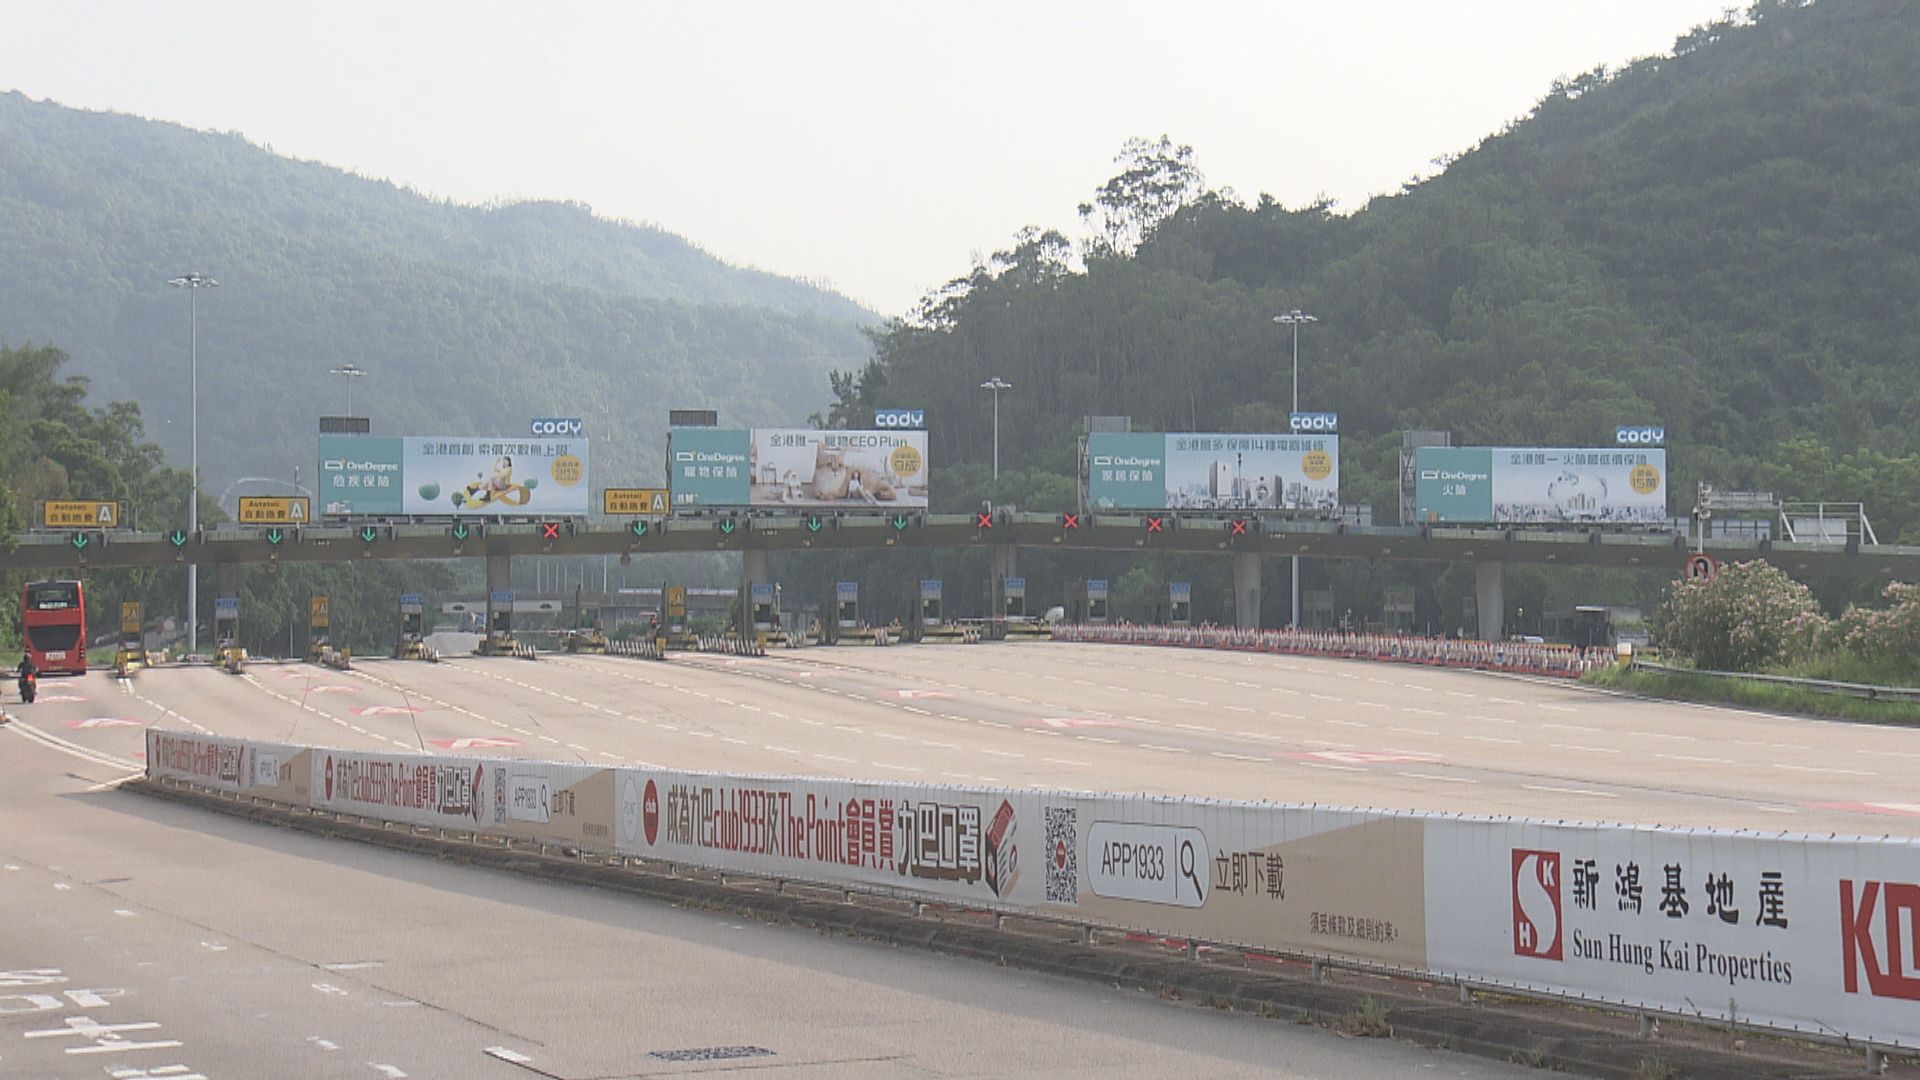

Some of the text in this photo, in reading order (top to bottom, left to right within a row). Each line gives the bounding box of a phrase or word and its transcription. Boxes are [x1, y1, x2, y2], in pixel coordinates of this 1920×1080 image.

[876, 412, 923, 427] cody
[1290, 415, 1337, 430] cody
[532, 420, 582, 435] cody
[879, 435, 908, 448] Plan
[1616, 429, 1664, 444] cody
[697, 453, 745, 464] OneDegree
[1114, 457, 1161, 468] OneDegree
[346, 461, 398, 472] OneDegree
[332, 474, 390, 488] 危疾保險
[1441, 471, 1488, 481] OneDegree
[1442, 484, 1466, 496] 火險
[652, 495, 664, 510] A
[99, 506, 112, 522] A
[290, 503, 303, 519] A
[1101, 840, 1165, 881] APP1933
[1215, 848, 1285, 900] 立即下載
[1573, 928, 1793, 985] Sun Hung Kai Properties
